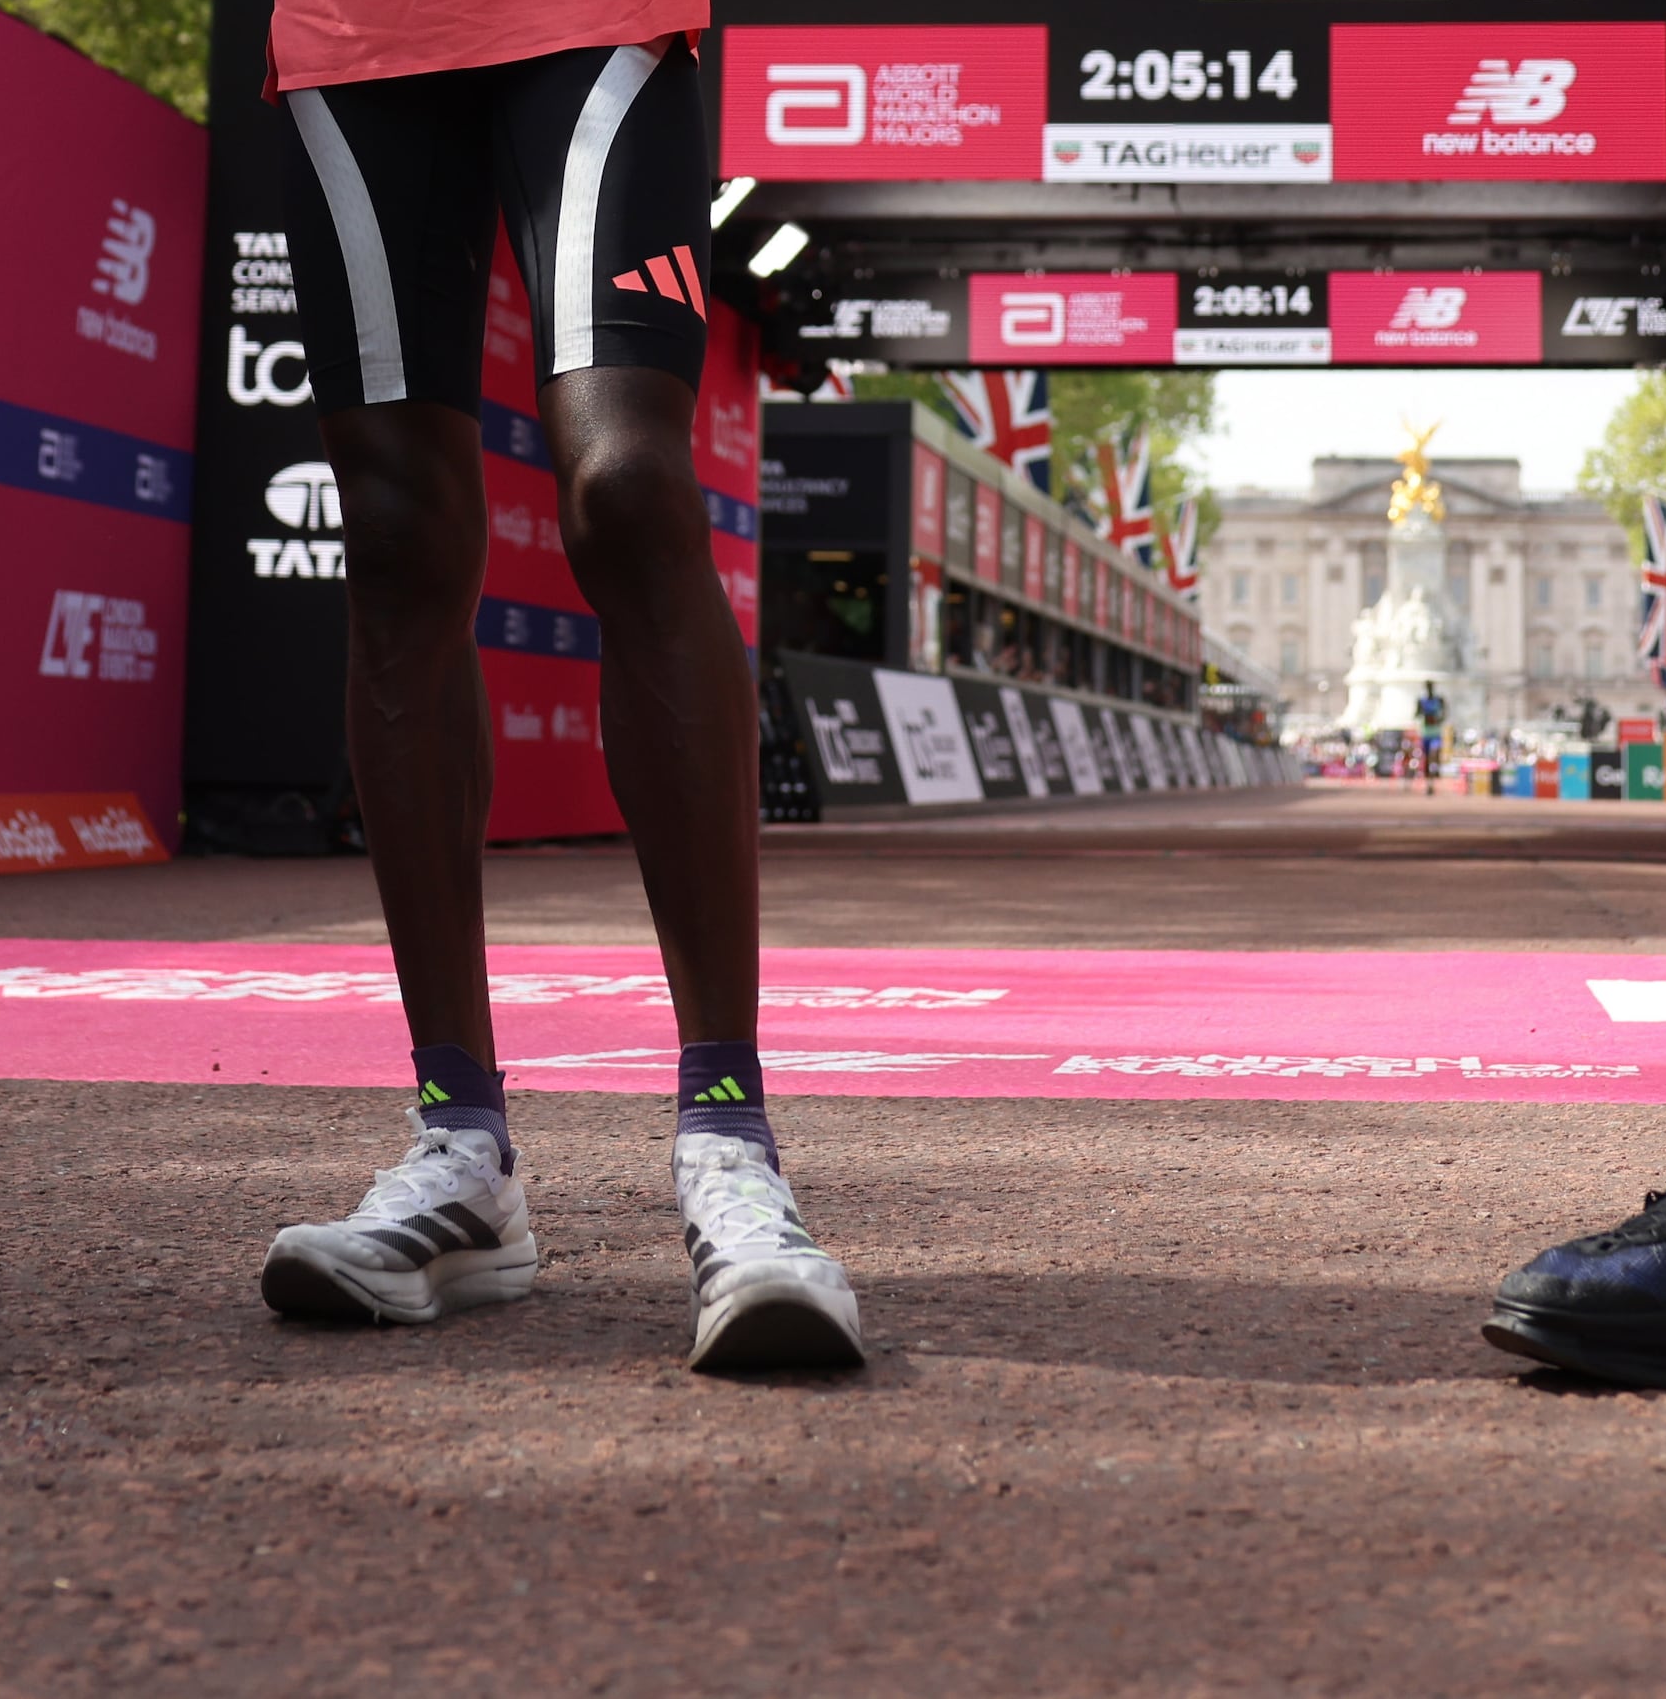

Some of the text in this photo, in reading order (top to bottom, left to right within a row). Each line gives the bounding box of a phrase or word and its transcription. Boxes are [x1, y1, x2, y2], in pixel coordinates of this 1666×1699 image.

[872, 62, 964, 86] ABBOTT
[1078, 48, 1298, 102] 2:05:14
[870, 84, 960, 105] WORLD
[871, 104, 1001, 127] MARATHON
[871, 125, 964, 147] MAJORS
[1421, 127, 1599, 158] new balance
[1192, 285, 1314, 318] 2:05:14
[227, 324, 316, 407] tc
